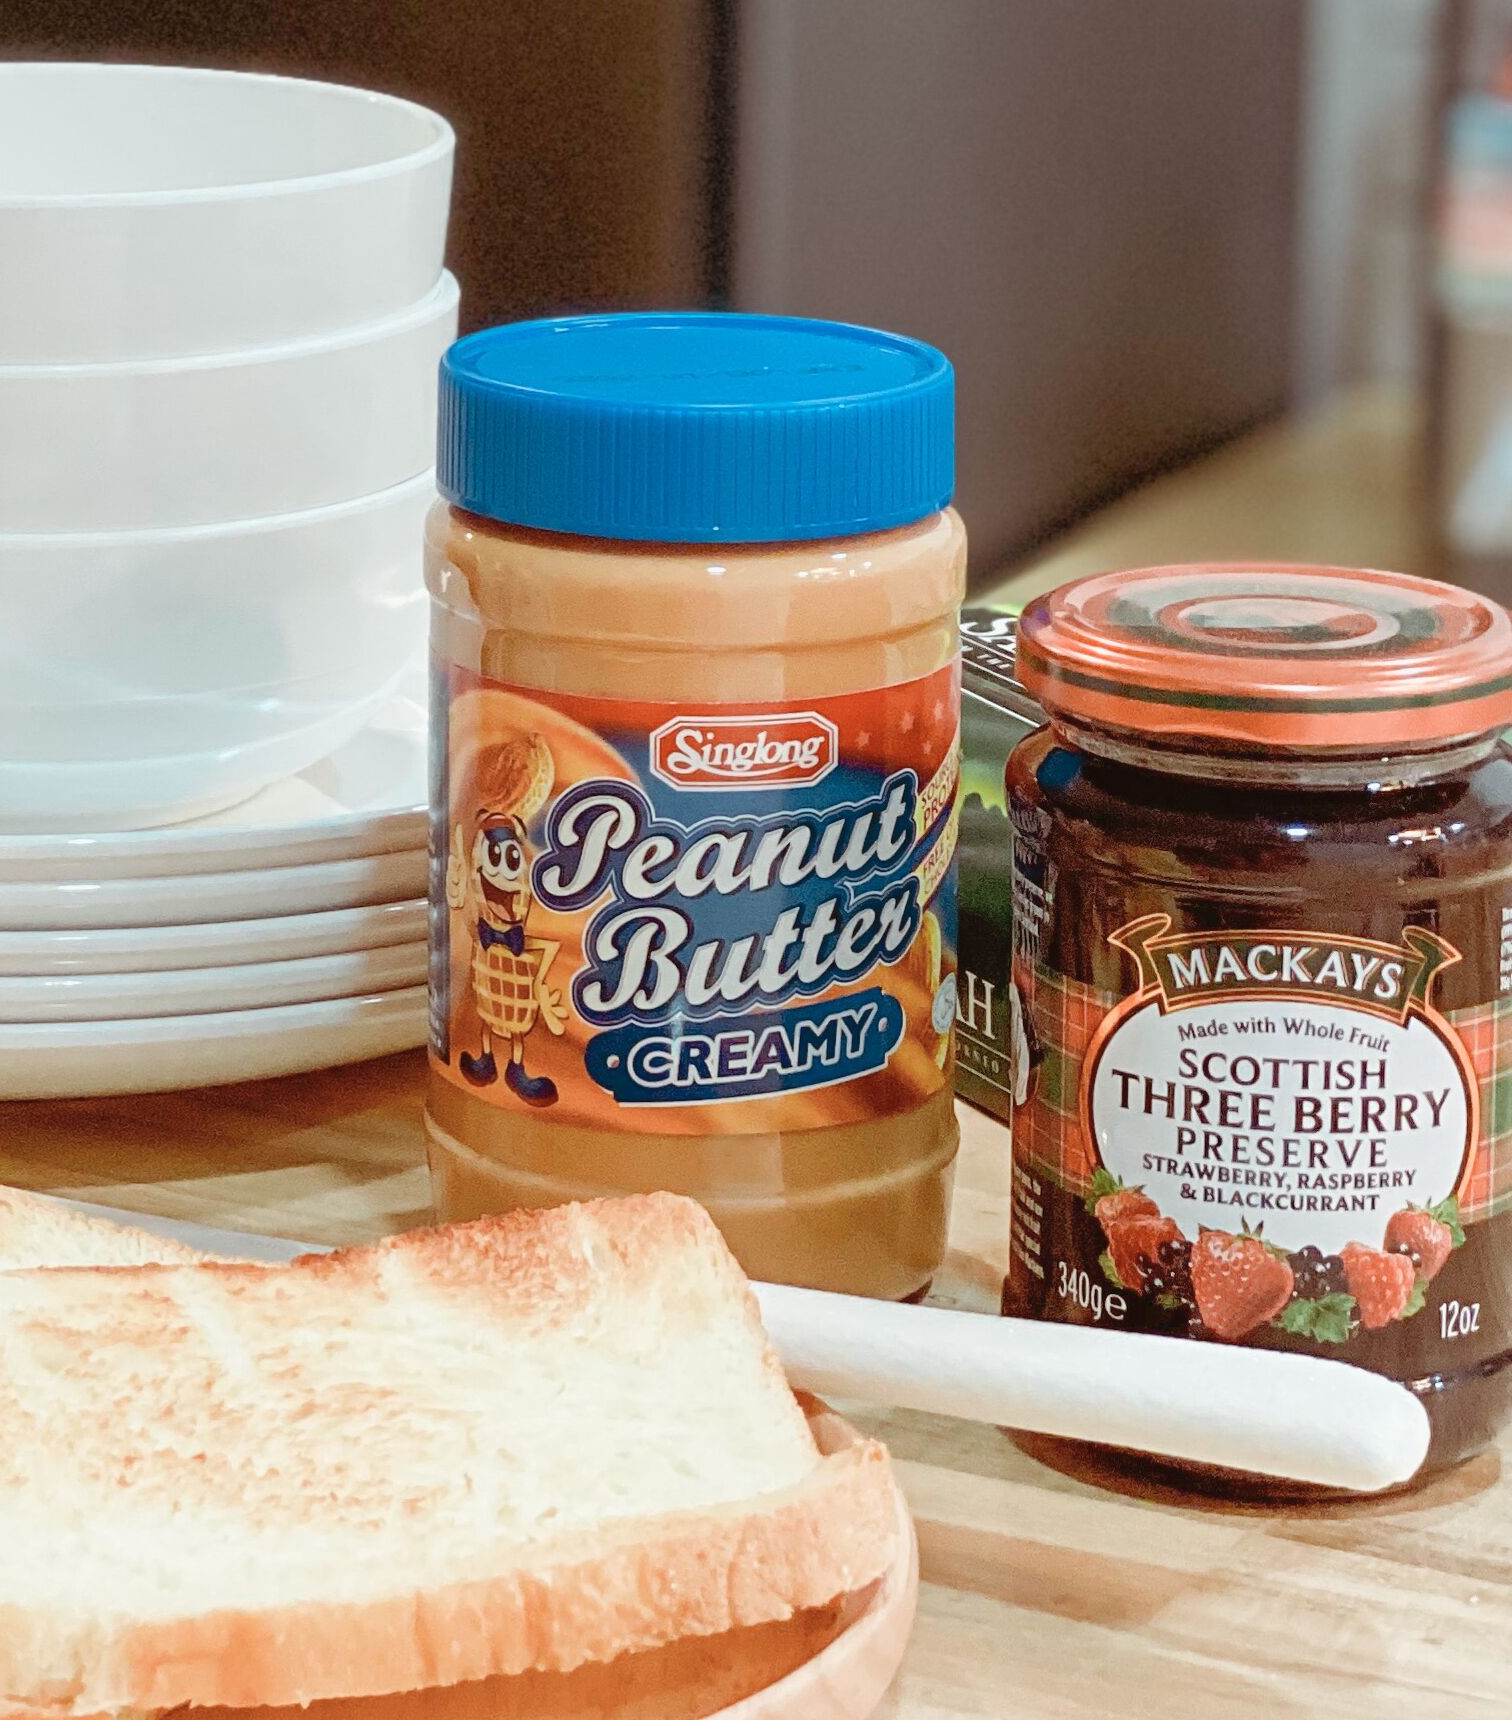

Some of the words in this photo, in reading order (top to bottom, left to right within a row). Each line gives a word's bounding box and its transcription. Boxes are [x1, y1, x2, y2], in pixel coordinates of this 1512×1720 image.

[666, 728, 826, 777] Singlong
[541, 783, 907, 900] Peanut
[581, 887, 913, 1013] Butter
[1166, 943, 1405, 1000] MACKAYS
[626, 1002, 879, 1088] CREAMY
[1177, 1016, 1229, 1042] Made
[1233, 1015, 1277, 1035] with
[1283, 1016, 1345, 1042] Whole
[1348, 1026, 1391, 1053] Fruit
[1178, 1048, 1387, 1091] SCOTTISH
[1112, 1068, 1276, 1132] THREE
[1293, 1088, 1451, 1134] BERRY
[1176, 1126, 1388, 1169] PRESERVE
[1142, 1153, 1293, 1192] STRAWBERRY,
[1297, 1169, 1417, 1190] RASPBERRY
[1179, 1183, 1197, 1200] &
[1202, 1186, 1381, 1212] BLACKCURRANT
[1439, 1300, 1480, 1339] 12oz
